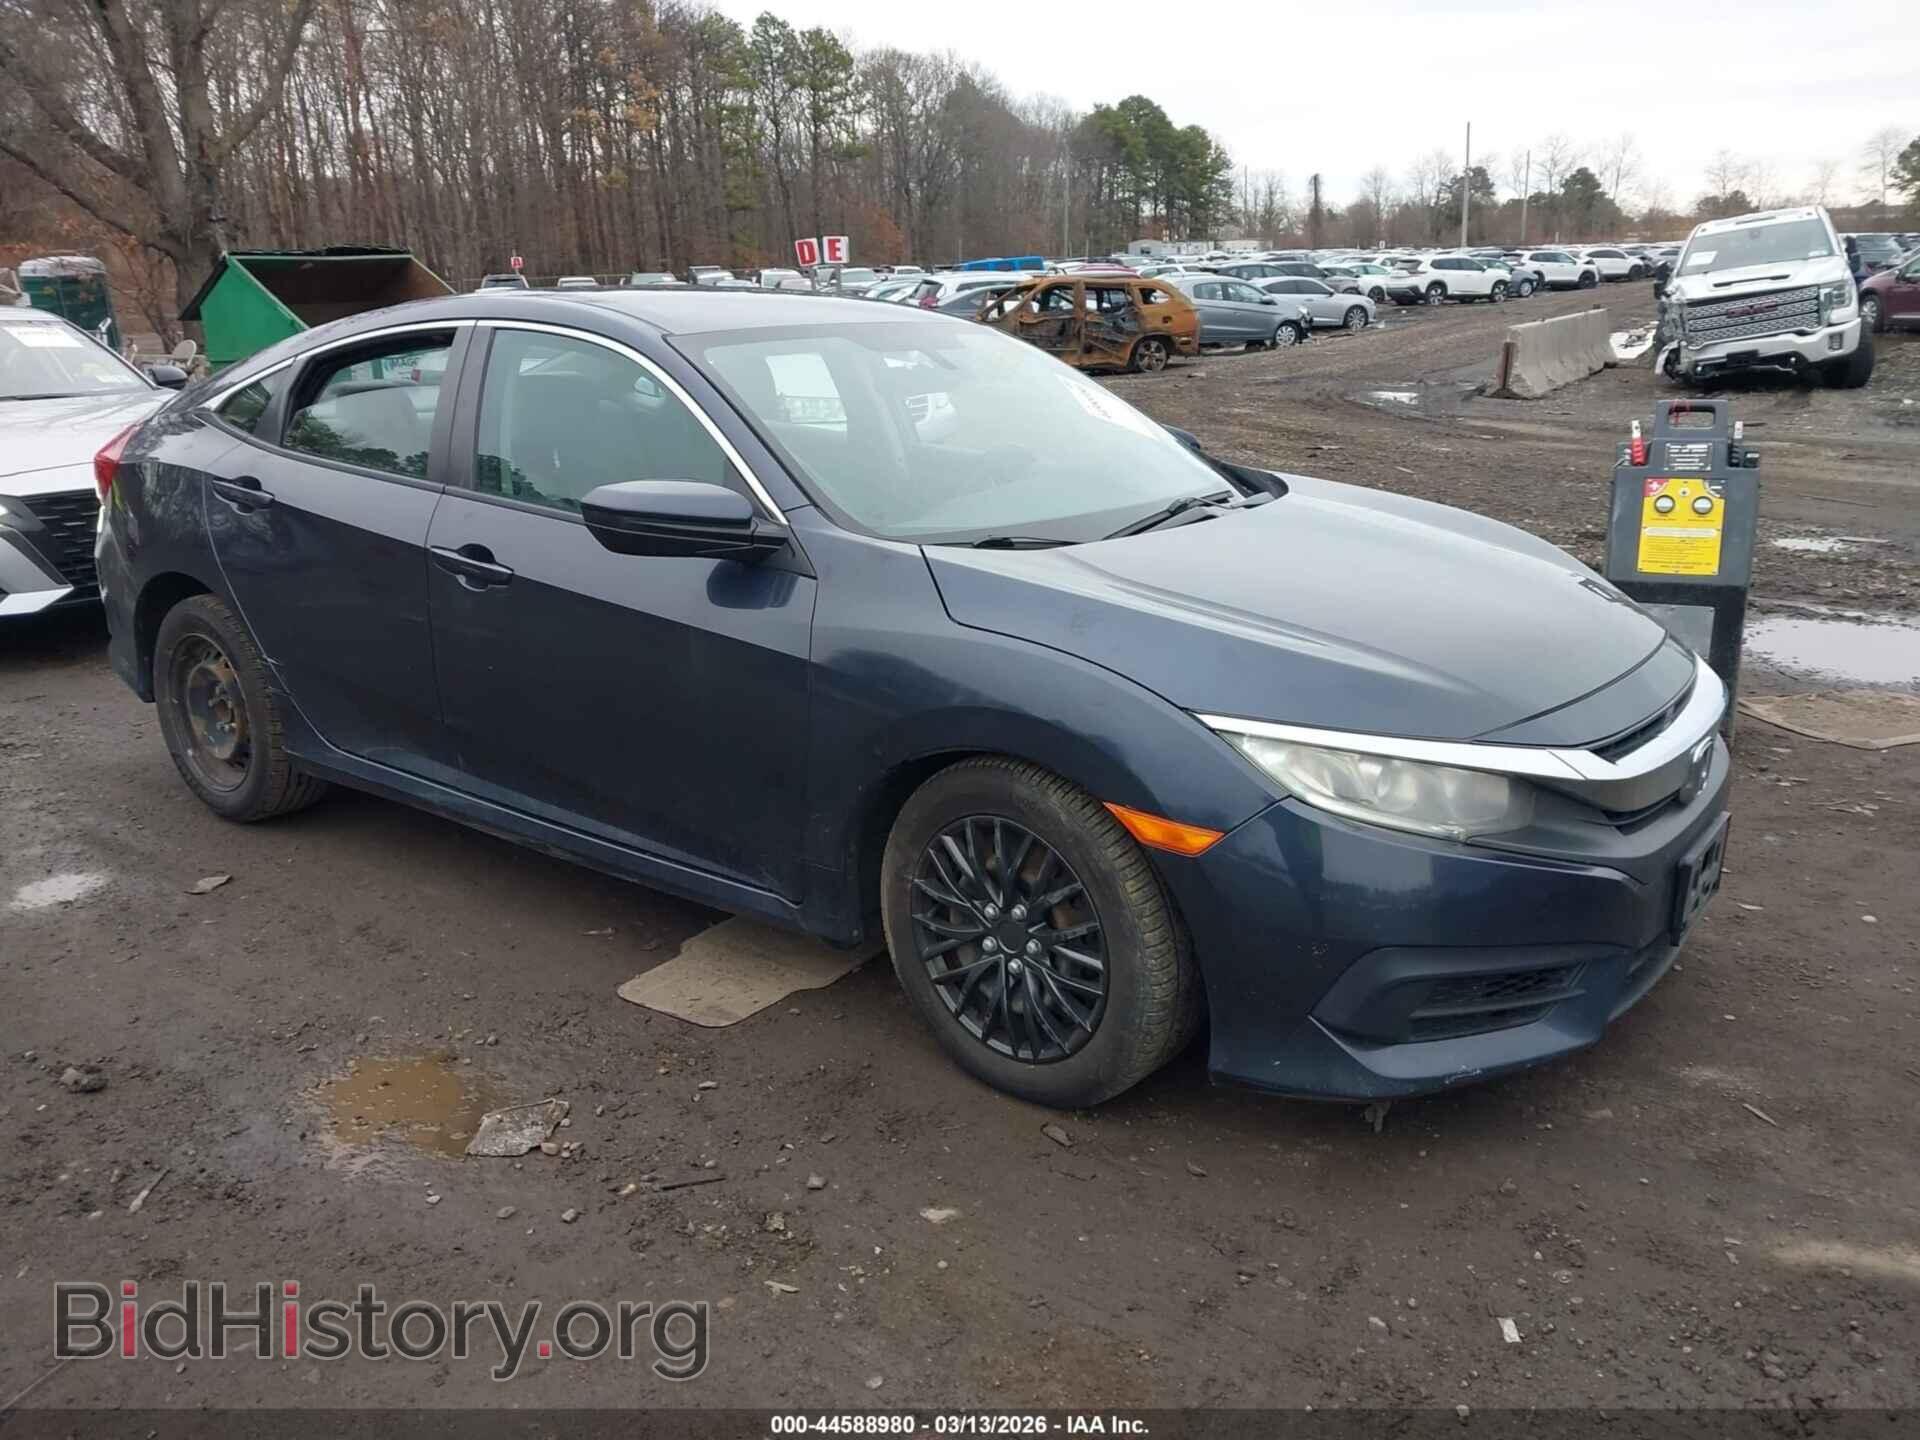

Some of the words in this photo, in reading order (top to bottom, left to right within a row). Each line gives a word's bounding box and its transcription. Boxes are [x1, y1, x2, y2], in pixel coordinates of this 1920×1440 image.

[797, 240, 817, 264] D
[827, 238, 843, 261] E
[1727, 300, 1777, 318] GMC
